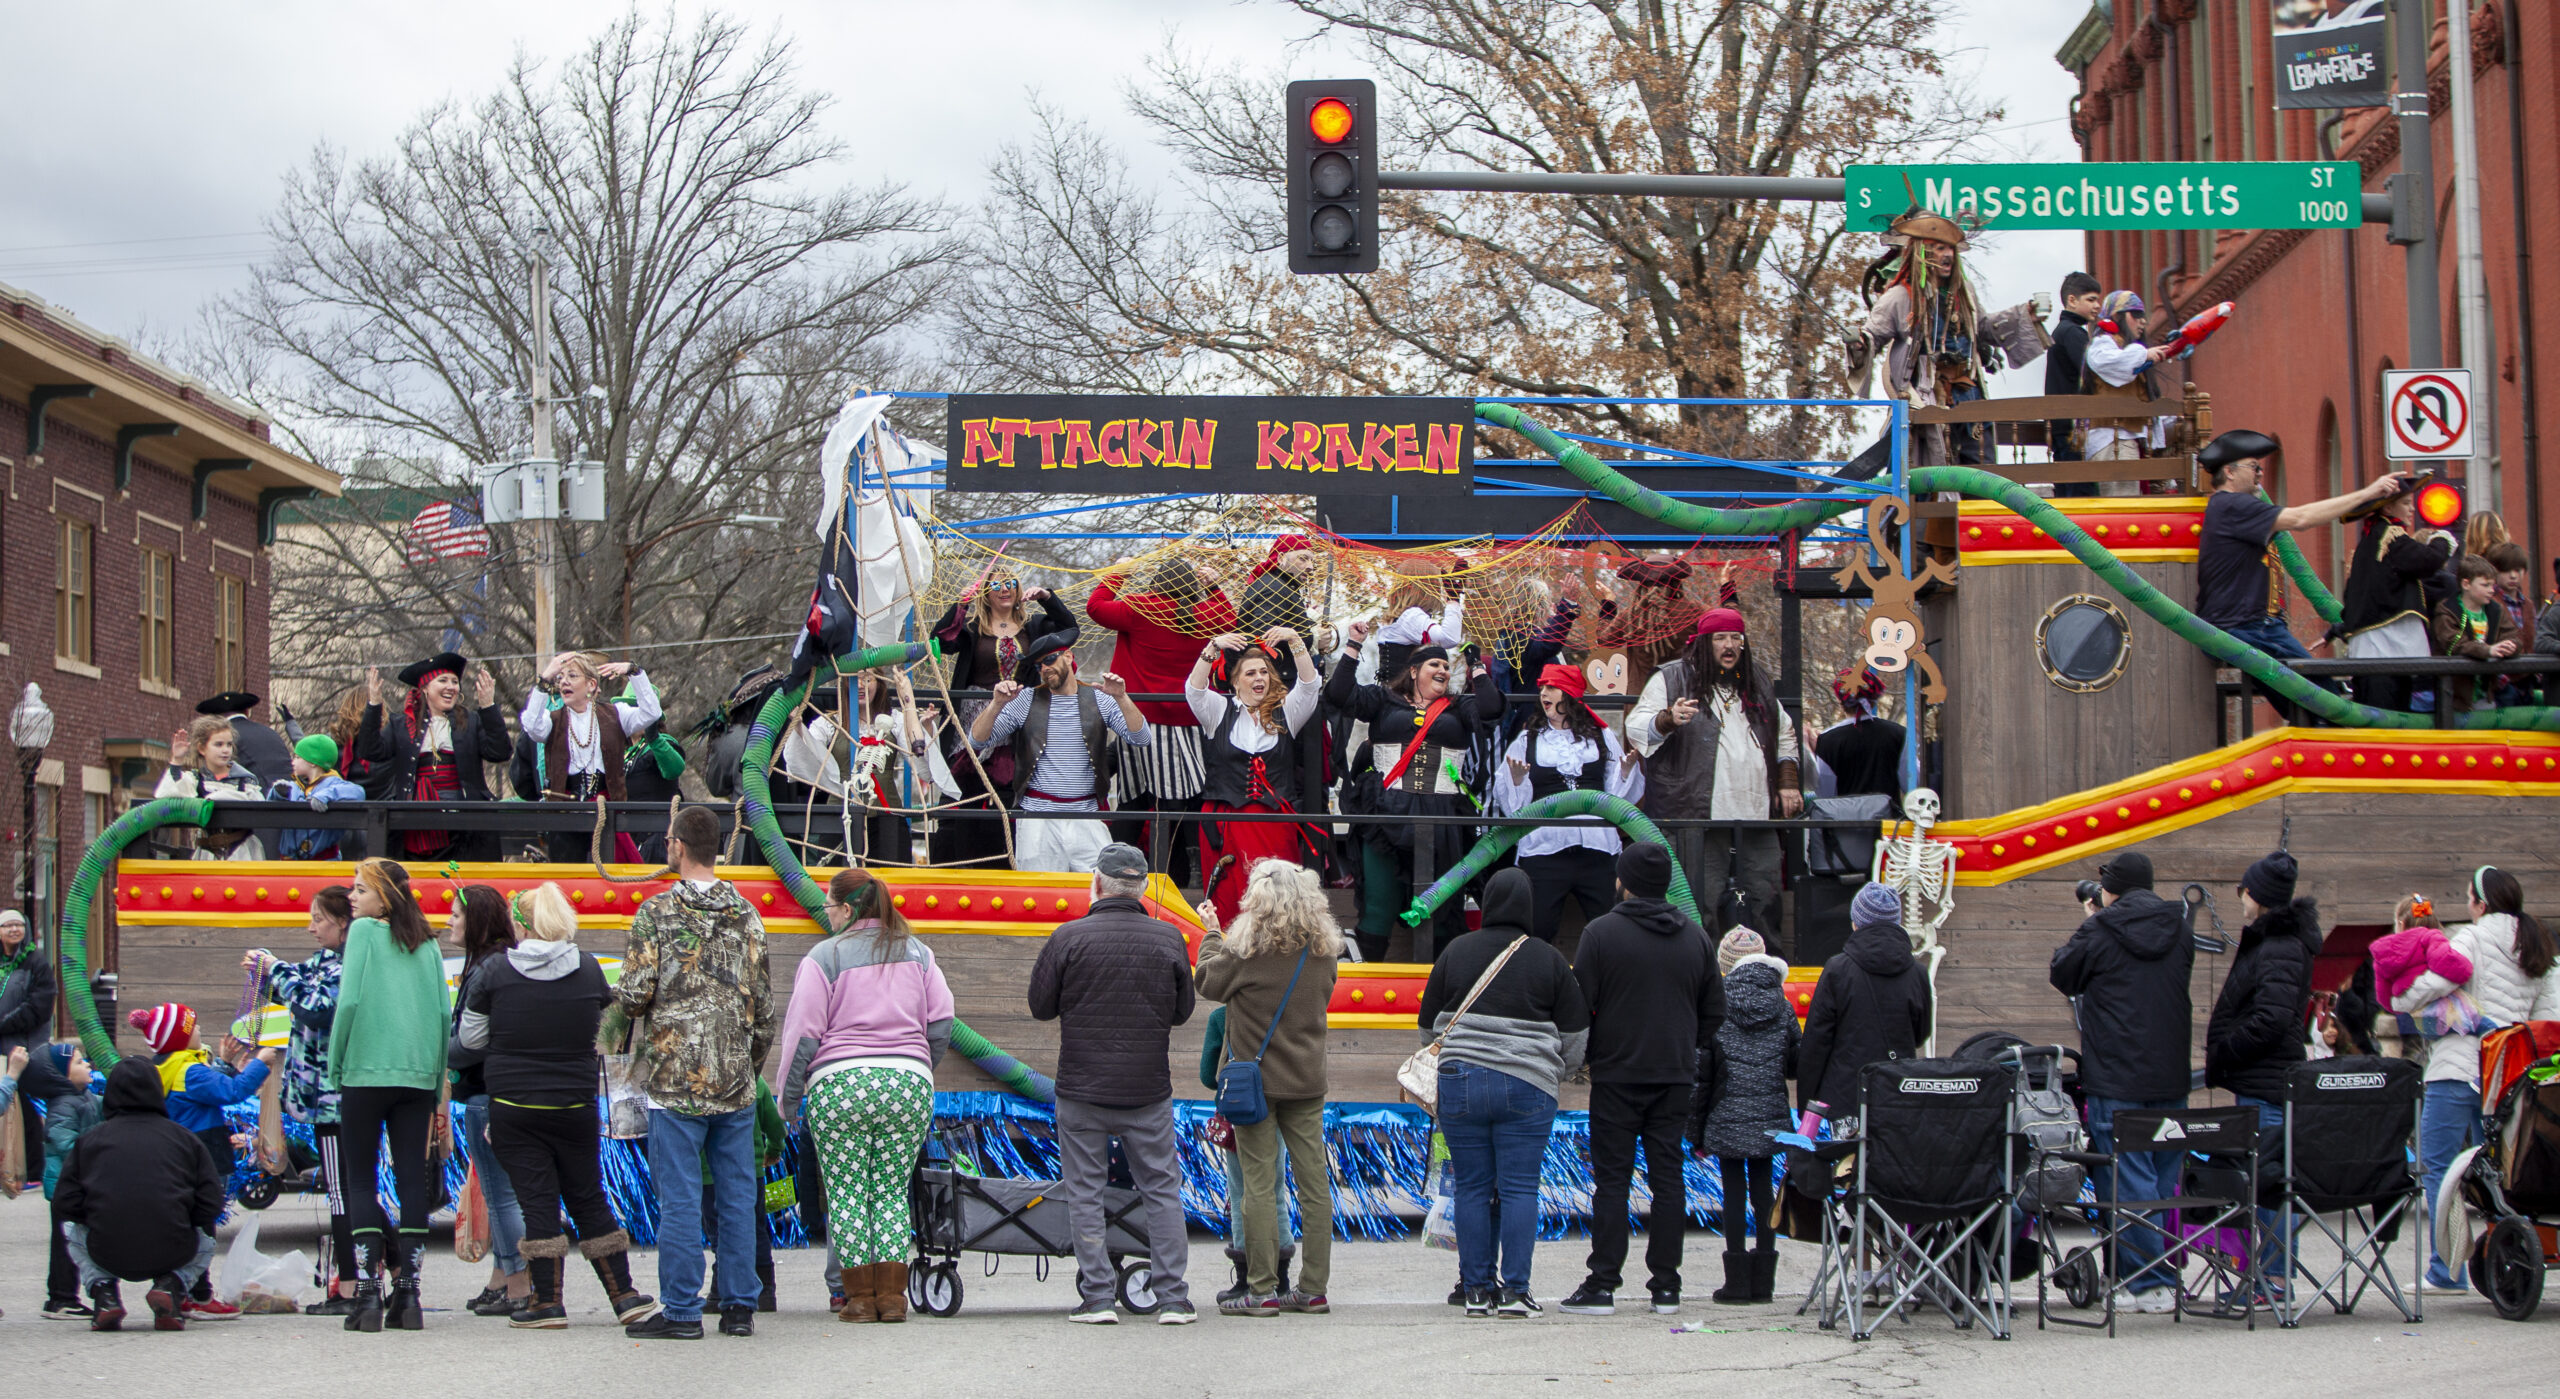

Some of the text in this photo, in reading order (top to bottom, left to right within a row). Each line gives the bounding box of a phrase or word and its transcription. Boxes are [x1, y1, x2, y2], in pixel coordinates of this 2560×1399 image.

[2286, 52, 2376, 91] LAWRENCE
[2310, 167, 2335, 188] ST
[1858, 177, 2240, 218] S Massachusetts
[2299, 201, 2348, 222] 1000
[962, 417, 1464, 474] ATTACKIN KRAKEN
[1904, 1081, 1974, 1092] GUIDESMAN
[2321, 1075, 2383, 1088] GUIDESMAN
